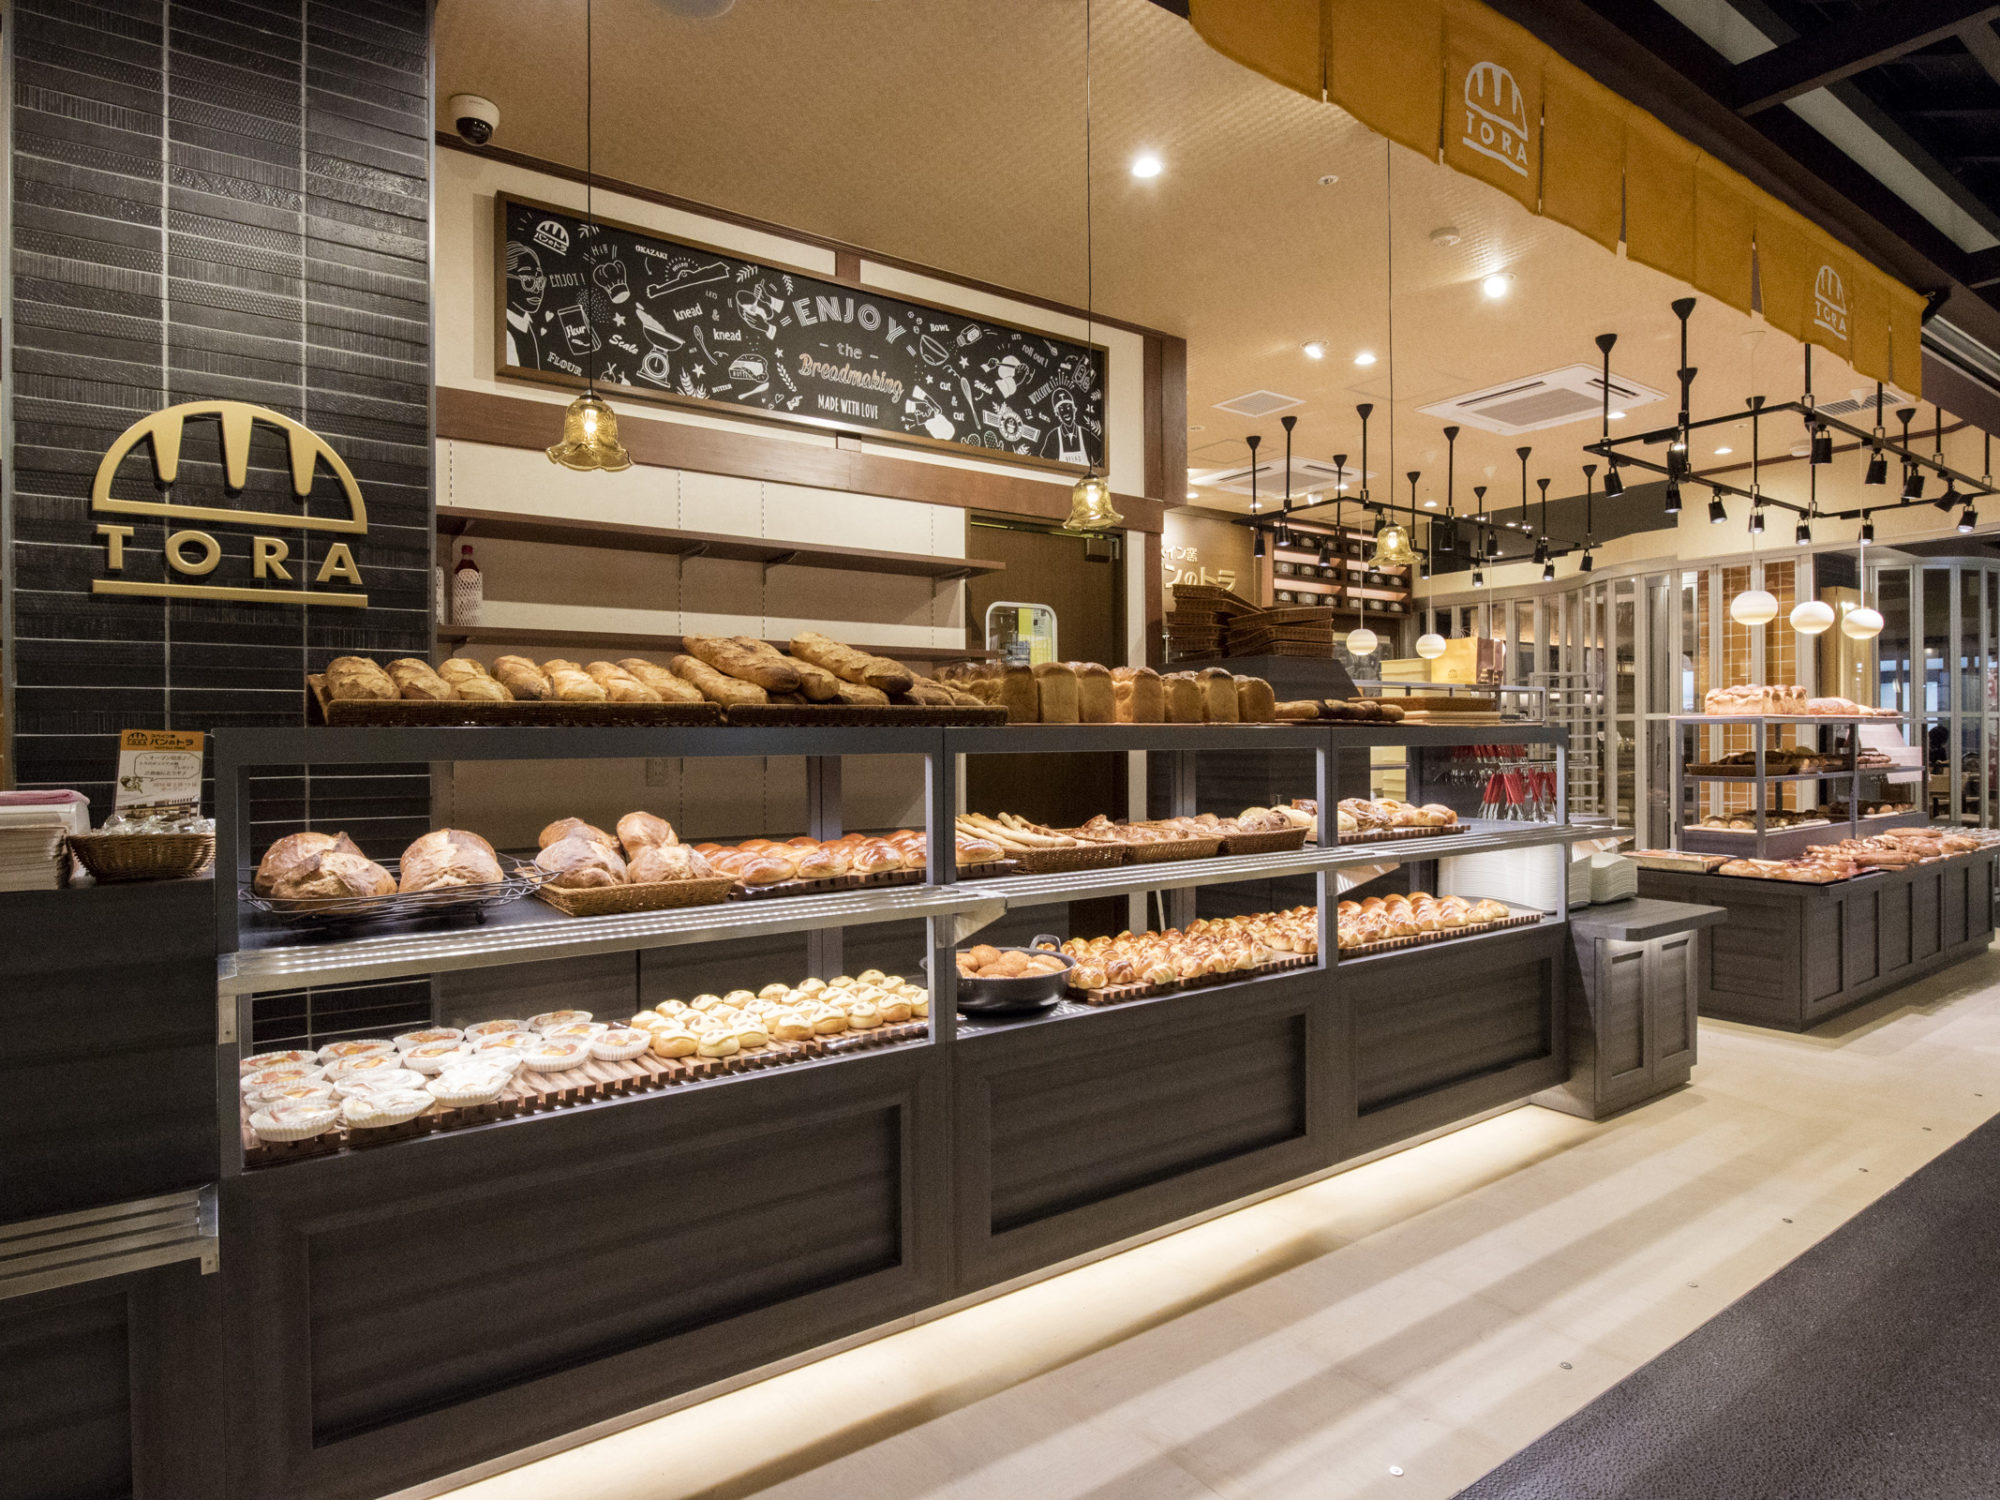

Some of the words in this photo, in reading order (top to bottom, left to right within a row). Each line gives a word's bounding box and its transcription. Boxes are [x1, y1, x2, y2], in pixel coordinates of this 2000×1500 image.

[1466, 110, 1528, 165] TORA
[634, 244, 668, 260] OKAZAKI
[673, 303, 703, 321] knead
[712, 309, 719, 321] &
[792, 296, 907, 344] ENJOY
[1815, 301, 1846, 332] TORA
[609, 335, 638, 355] Scale
[713, 328, 742, 341] knead
[547, 351, 582, 377] FLOUR
[837, 342, 862, 360] the
[798, 353, 904, 404] Breadmaking
[818, 394, 839, 413] MADE
[840, 398, 860, 417] WITH
[861, 402, 879, 420] LOVE
[97, 524, 363, 585] TORA
